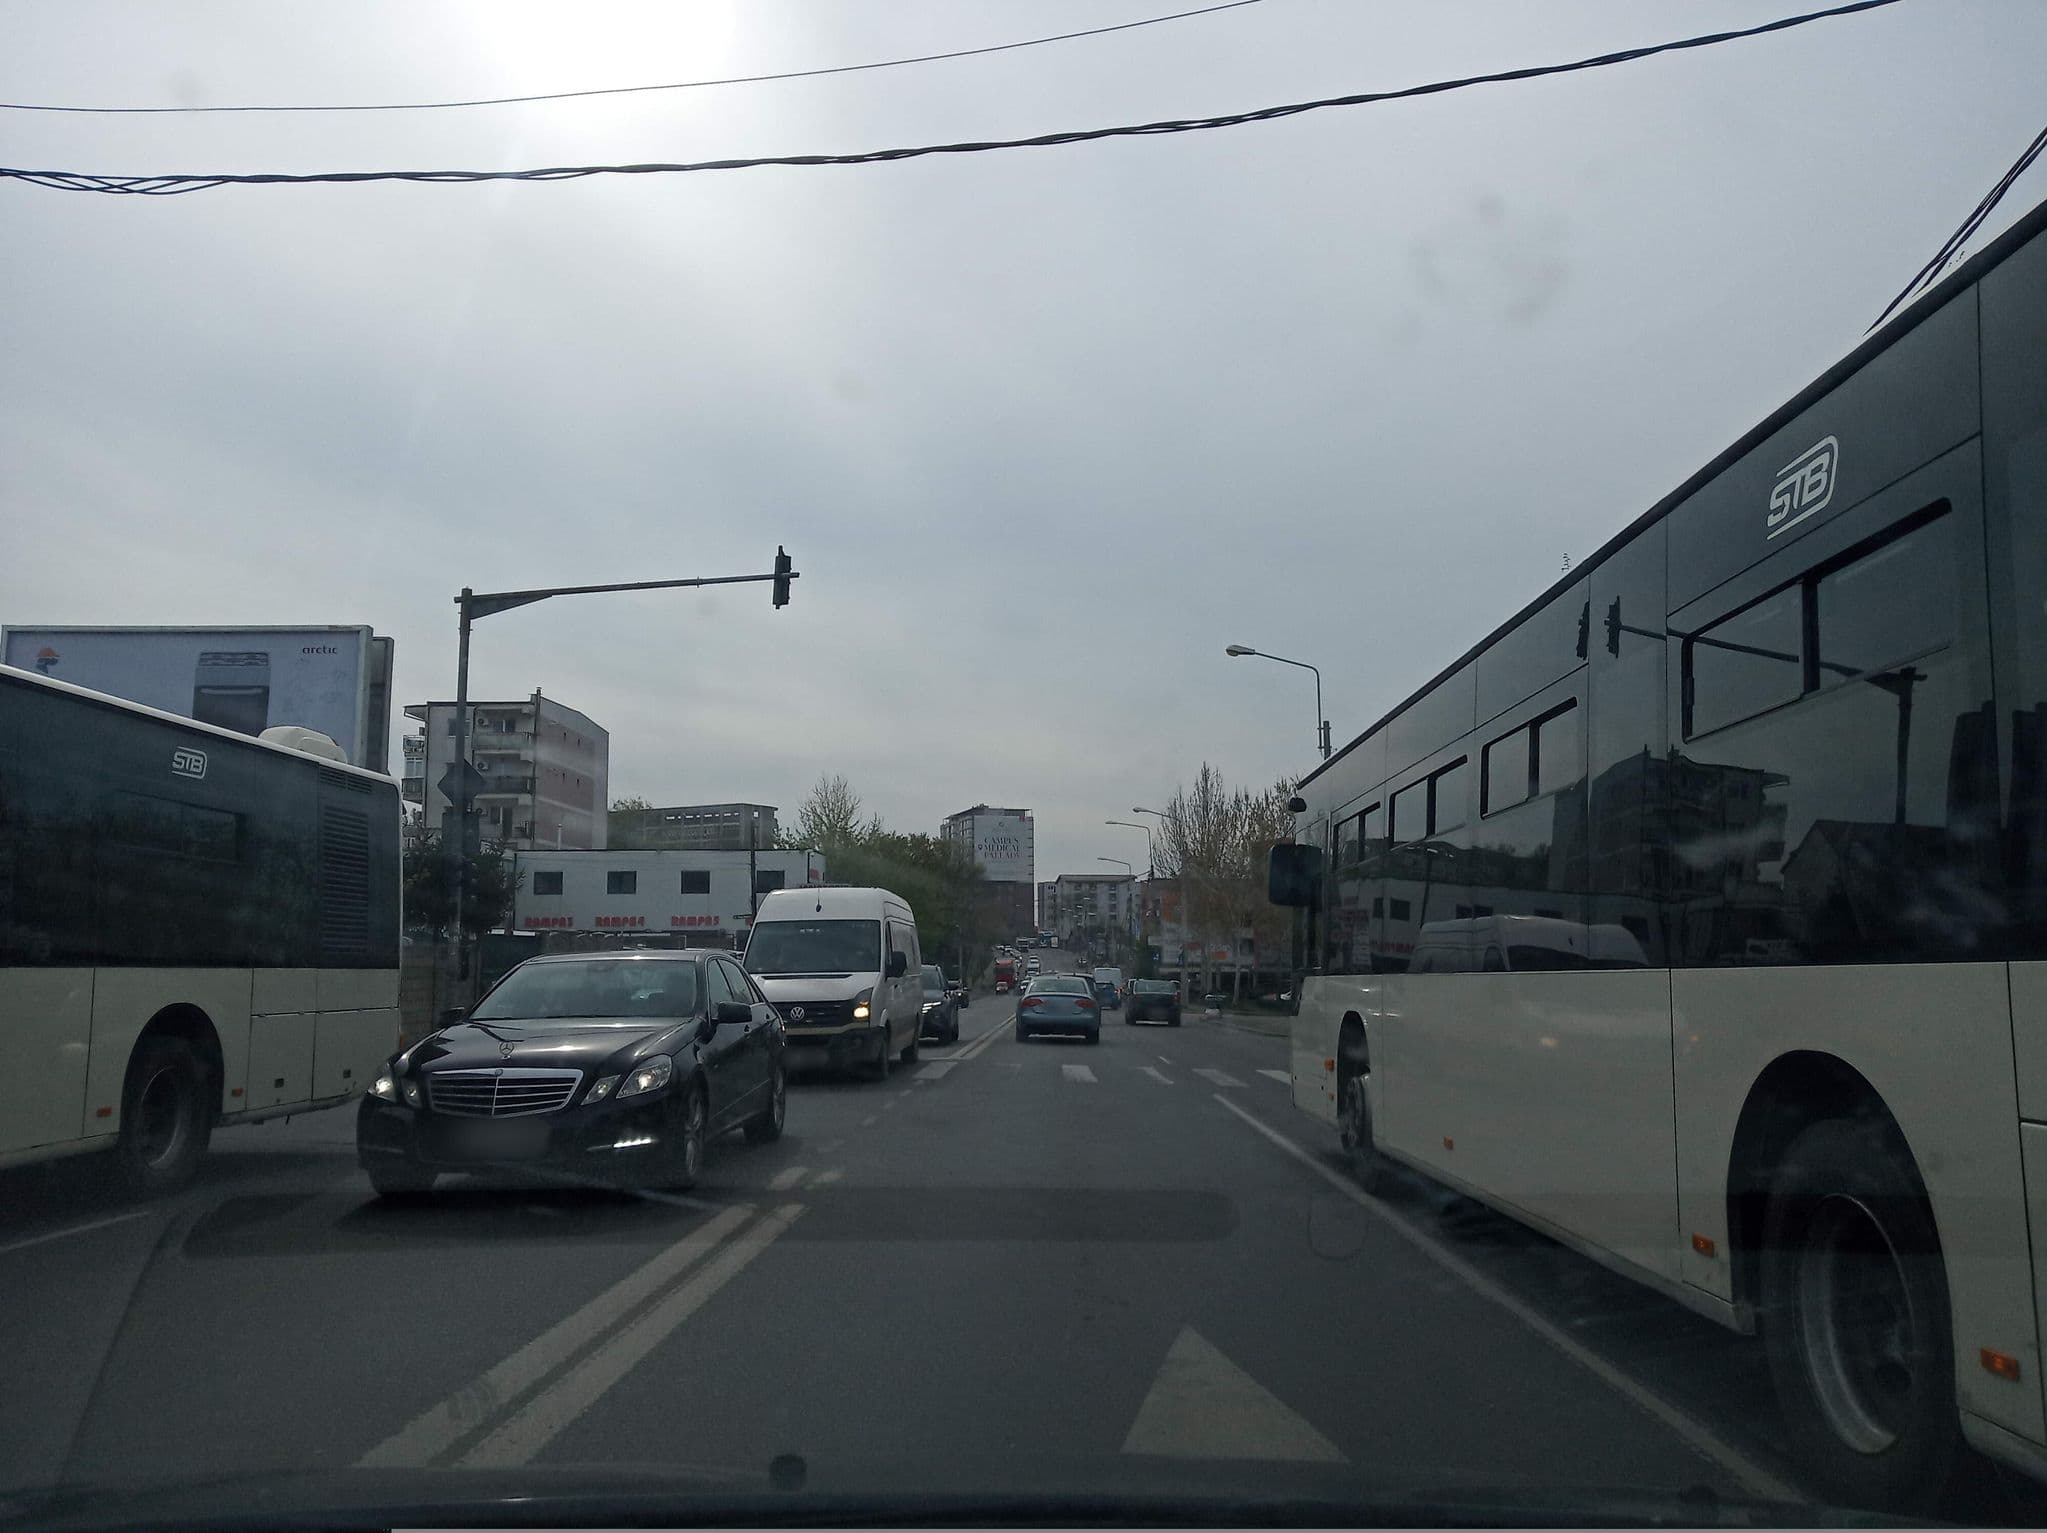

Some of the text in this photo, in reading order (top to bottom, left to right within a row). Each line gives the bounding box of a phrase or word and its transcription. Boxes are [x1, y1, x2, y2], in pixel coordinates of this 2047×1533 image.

[1767, 452, 1830, 527] STB
[302, 645, 337, 655] arctic
[172, 751, 204, 773] STB
[984, 836, 1019, 844] CAMPUS
[984, 844, 1020, 852] MEDICAL
